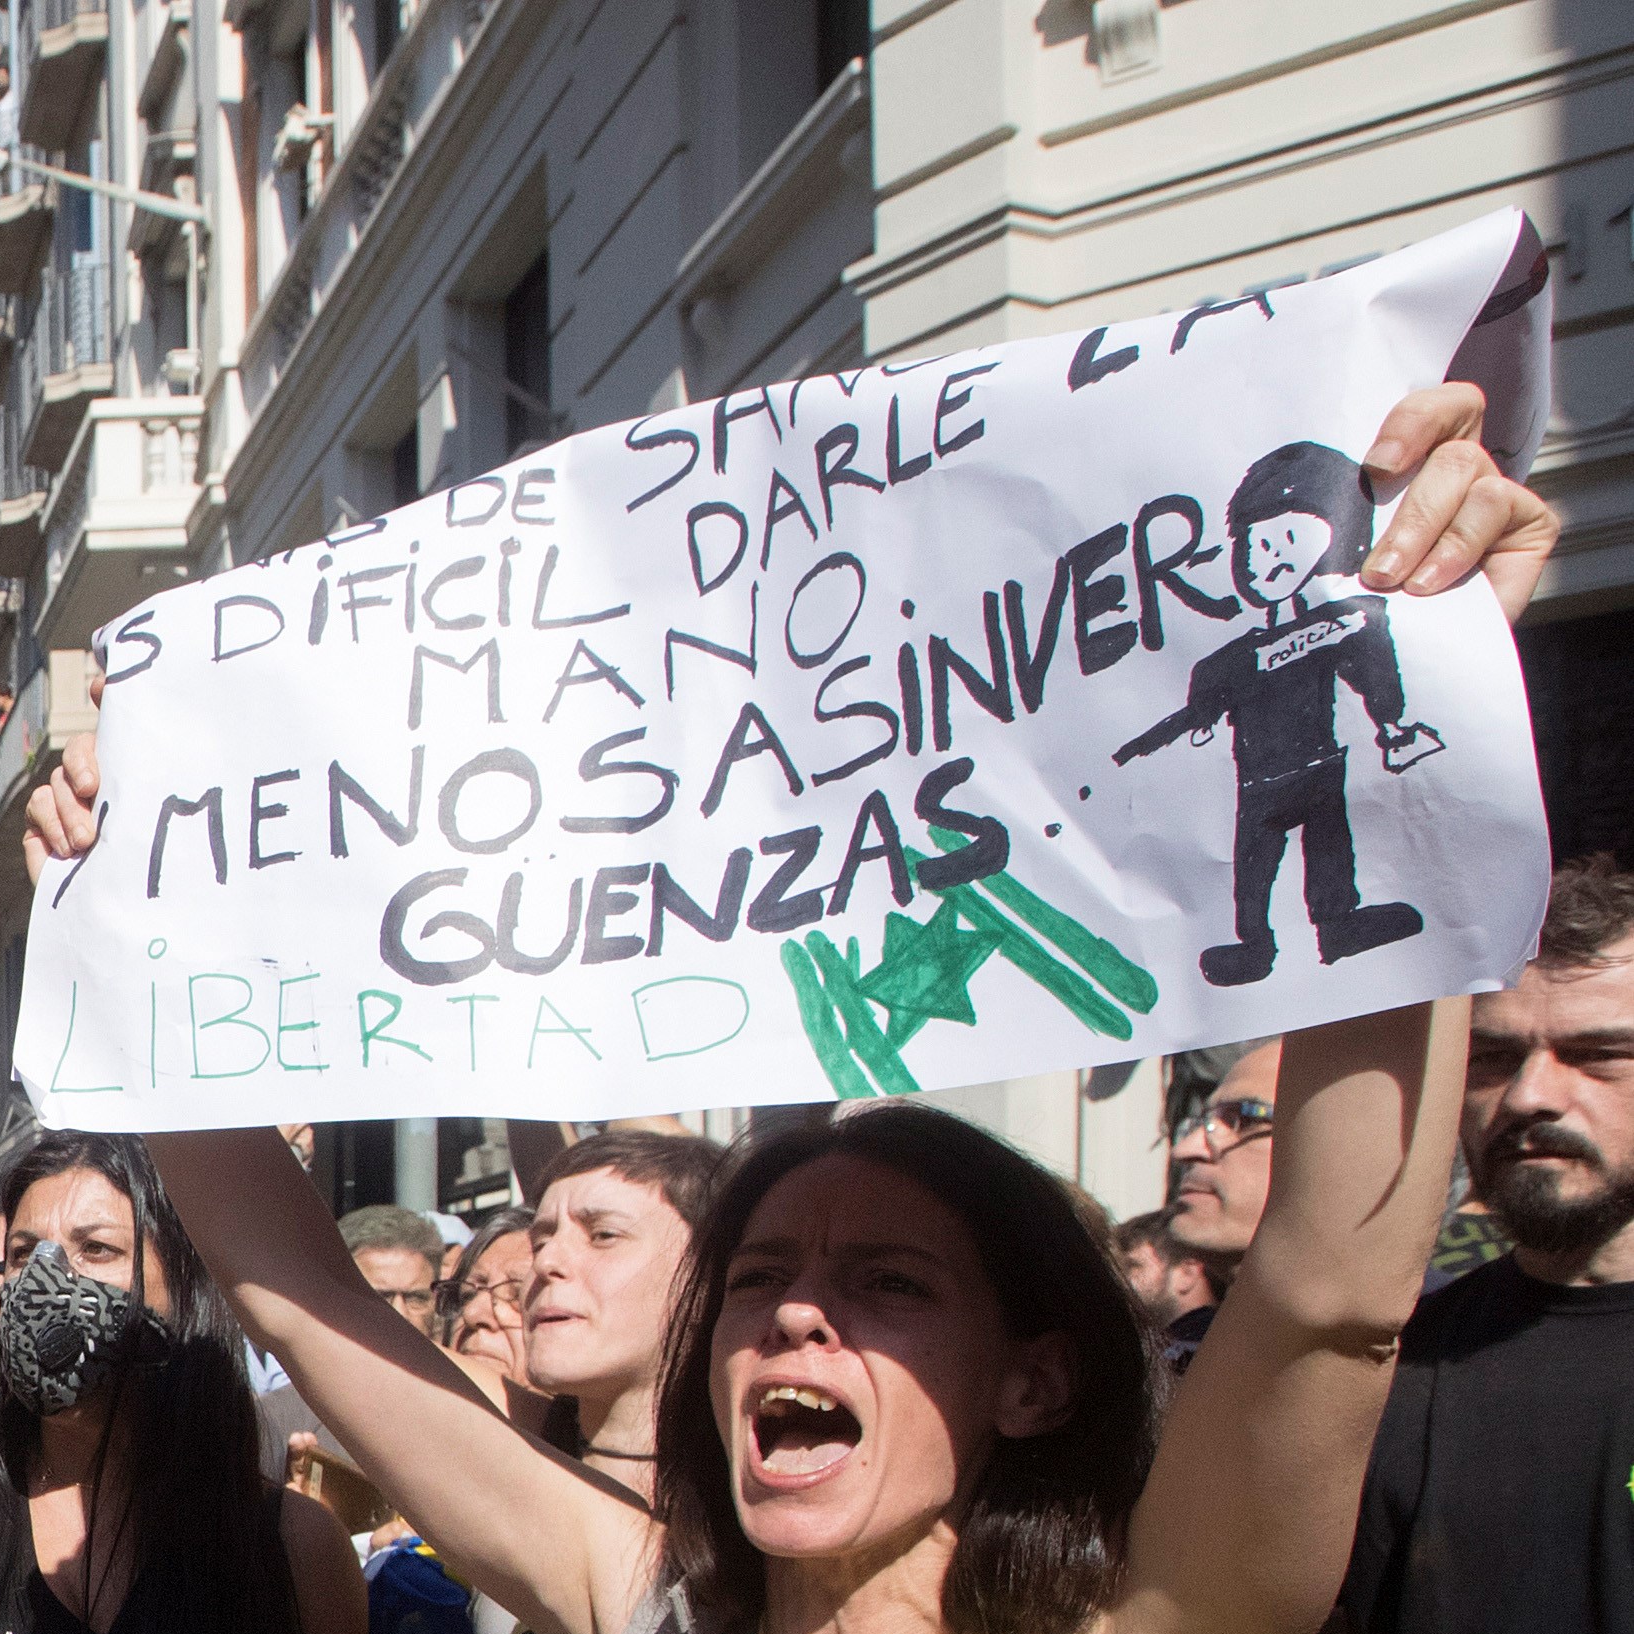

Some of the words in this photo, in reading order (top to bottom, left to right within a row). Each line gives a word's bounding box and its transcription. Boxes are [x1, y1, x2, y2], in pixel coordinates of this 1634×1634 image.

[446, 467, 557, 528] DE
[686, 360, 1004, 596] DARLE
[407, 551, 867, 731] MANO
[147, 727, 680, 899] MENOS
